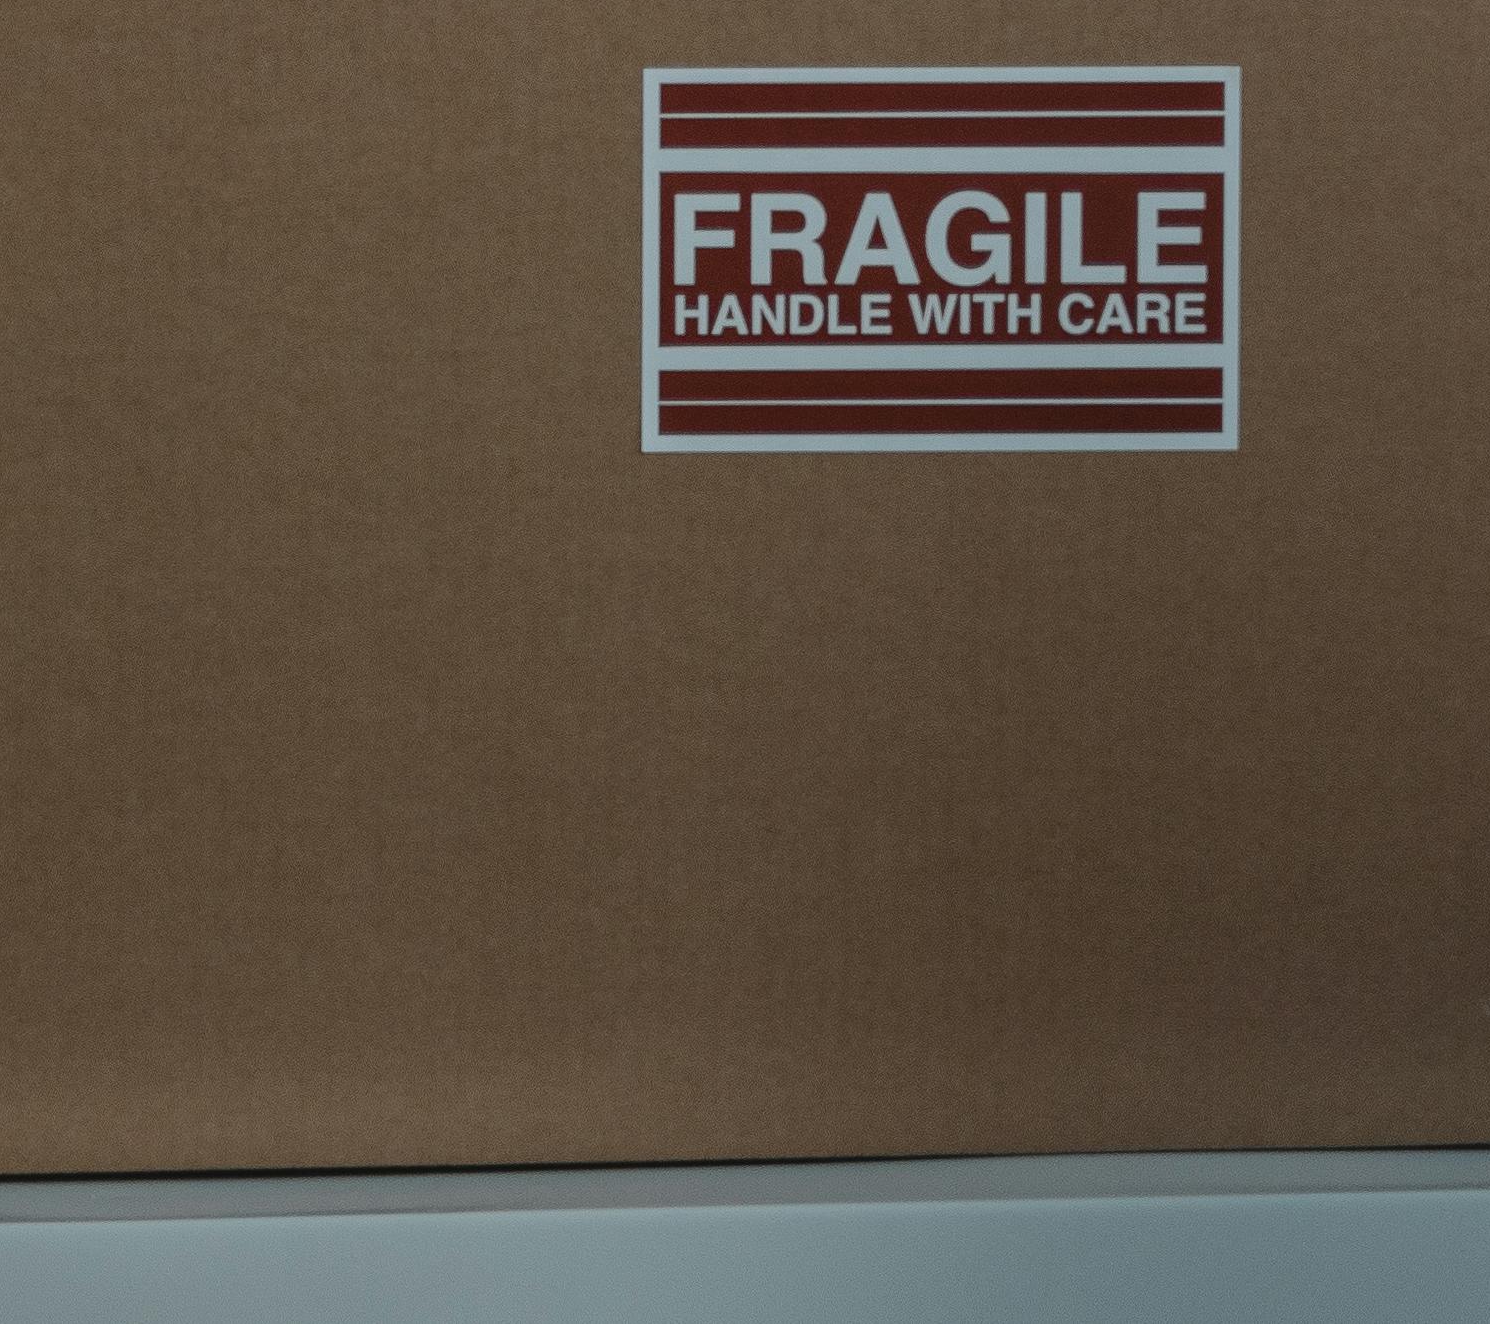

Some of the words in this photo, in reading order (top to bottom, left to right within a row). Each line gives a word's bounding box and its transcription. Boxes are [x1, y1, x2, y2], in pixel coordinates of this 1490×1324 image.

[673, 190, 1209, 287] FRAGILE
[674, 293, 893, 336] HANDLE
[907, 293, 1042, 335] WITH
[1058, 292, 1207, 335] CARE
